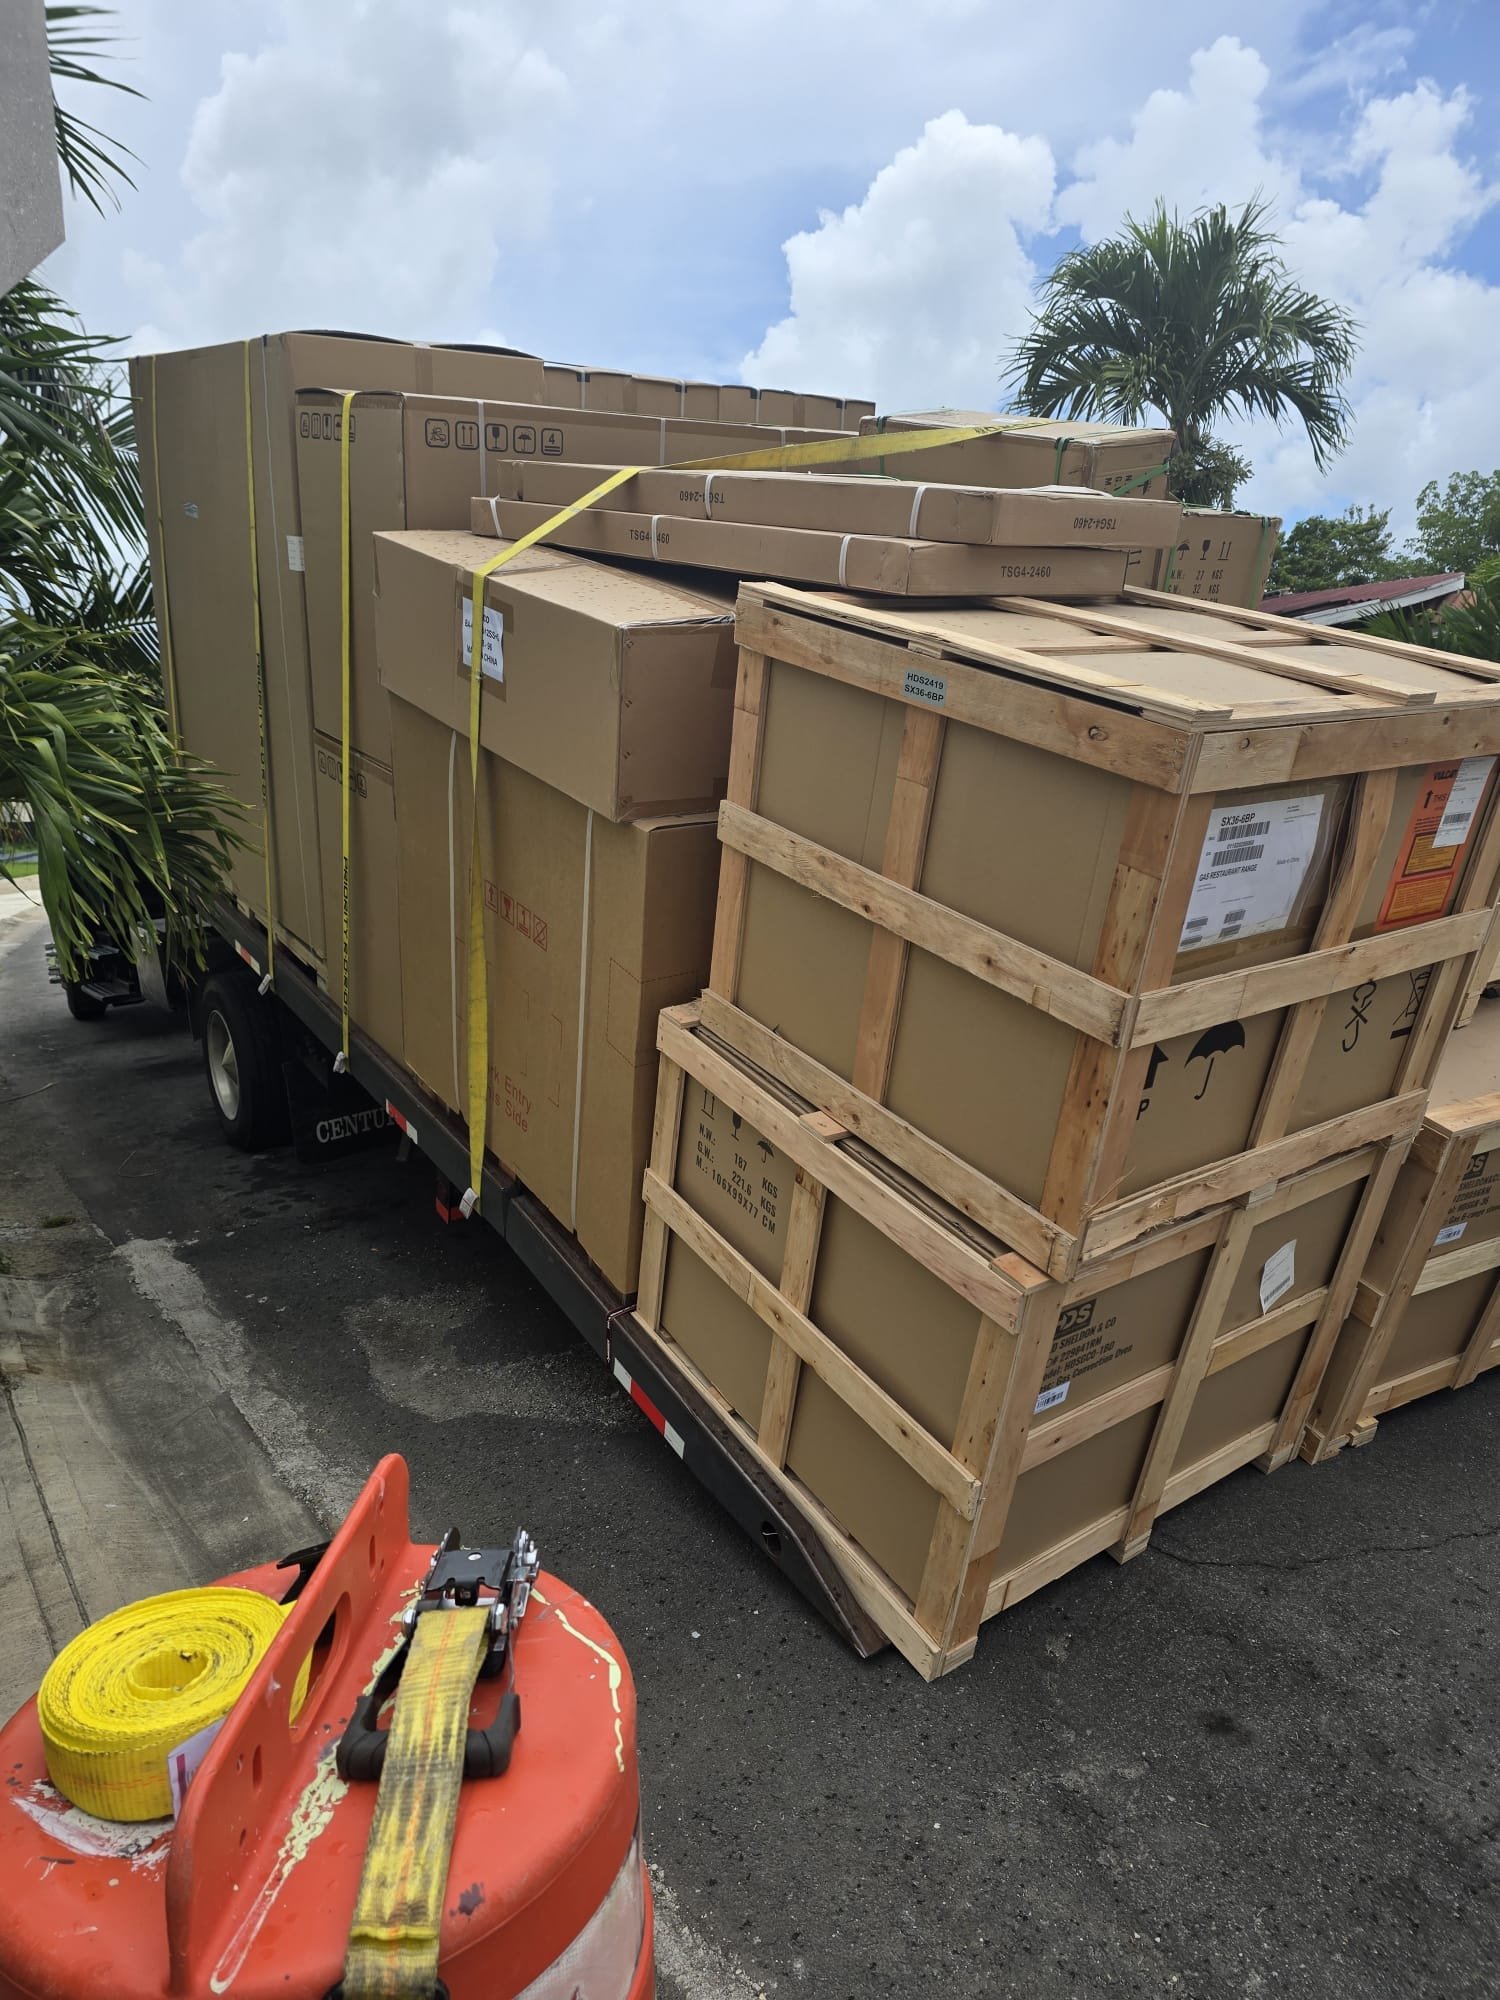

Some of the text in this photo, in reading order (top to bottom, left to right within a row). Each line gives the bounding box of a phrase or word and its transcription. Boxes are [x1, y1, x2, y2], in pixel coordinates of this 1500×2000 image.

[629, 529, 670, 545] TSG4-460
[1073, 517, 1117, 530] TSG4-2460
[1000, 565, 1051, 578] TSG4-2460
[904, 684, 945, 702] SX36-6BP
[907, 672, 944, 690] HDS2419
[1220, 812, 1256, 827] SX36-6BP
[1198, 864, 1258, 882] GAS RESTAURANT RANGE
[504, 1075, 532, 1115] Entry
[504, 1099, 528, 1132] Side
[1136, 1098, 1150, 1121] P
[316, 1107, 392, 1143] CENTU
[699, 1122, 778, 1199] N.W.: 187 KGS
[697, 1140, 777, 1218] G.W.: 221.6 KGS
[711, 1169, 759, 1219] 106X99X77
[762, 1215, 776, 1235] CM
[1059, 1324, 1097, 1350] SHELDON
[1104, 1316, 1117, 1330] CO
[1071, 1353, 1114, 1378] Convection
[1114, 1344, 1134, 1358] Oven
